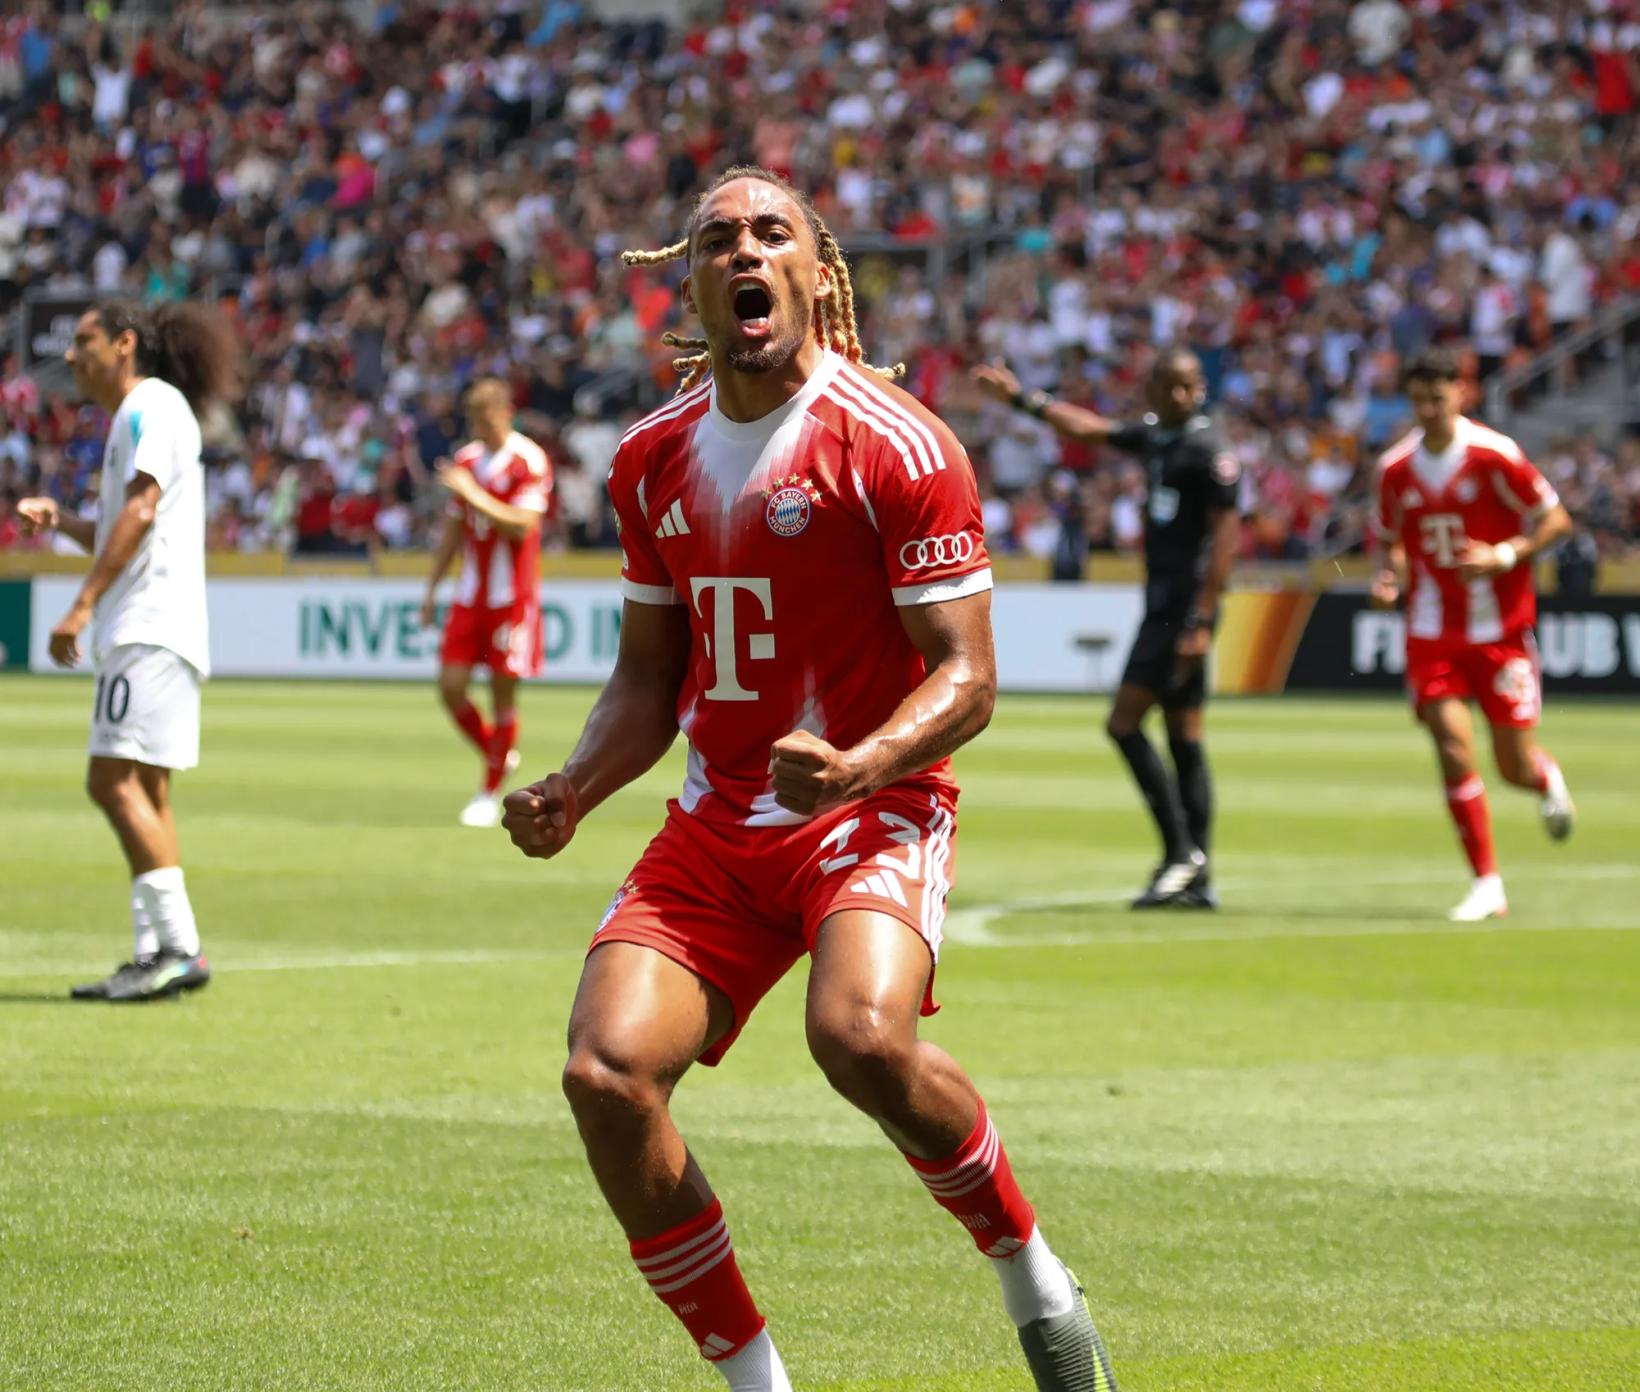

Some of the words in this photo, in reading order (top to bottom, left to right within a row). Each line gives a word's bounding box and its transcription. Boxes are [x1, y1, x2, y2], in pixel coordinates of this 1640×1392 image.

[781, 491, 807, 510] BAYERN
[299, 602, 572, 658] INVED
[690, 576, 776, 701] T
[1539, 612, 1620, 677] UB
[95, 673, 130, 724] 10
